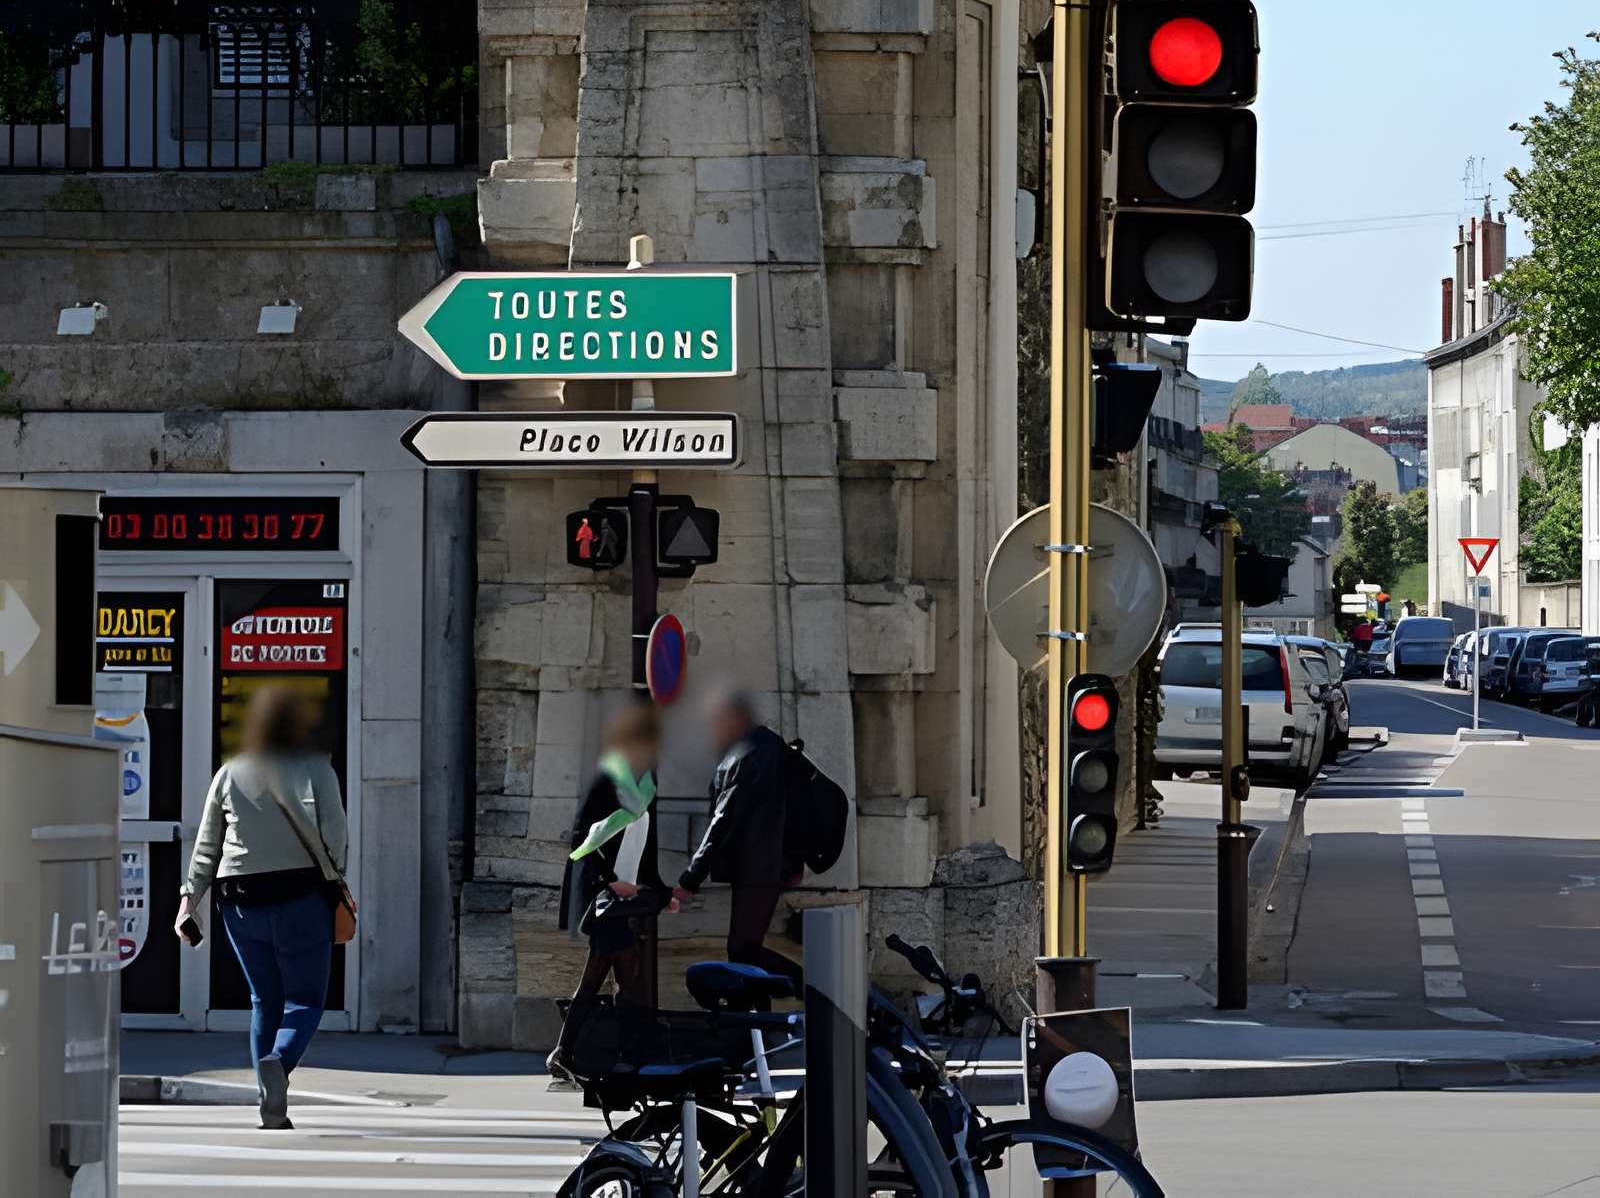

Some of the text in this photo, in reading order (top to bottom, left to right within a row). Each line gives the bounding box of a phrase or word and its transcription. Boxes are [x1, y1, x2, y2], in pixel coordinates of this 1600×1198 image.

[487, 289, 628, 320] TOUTES
[488, 329, 719, 361] DIRECTIONS
[622, 428, 725, 453] Wilson
